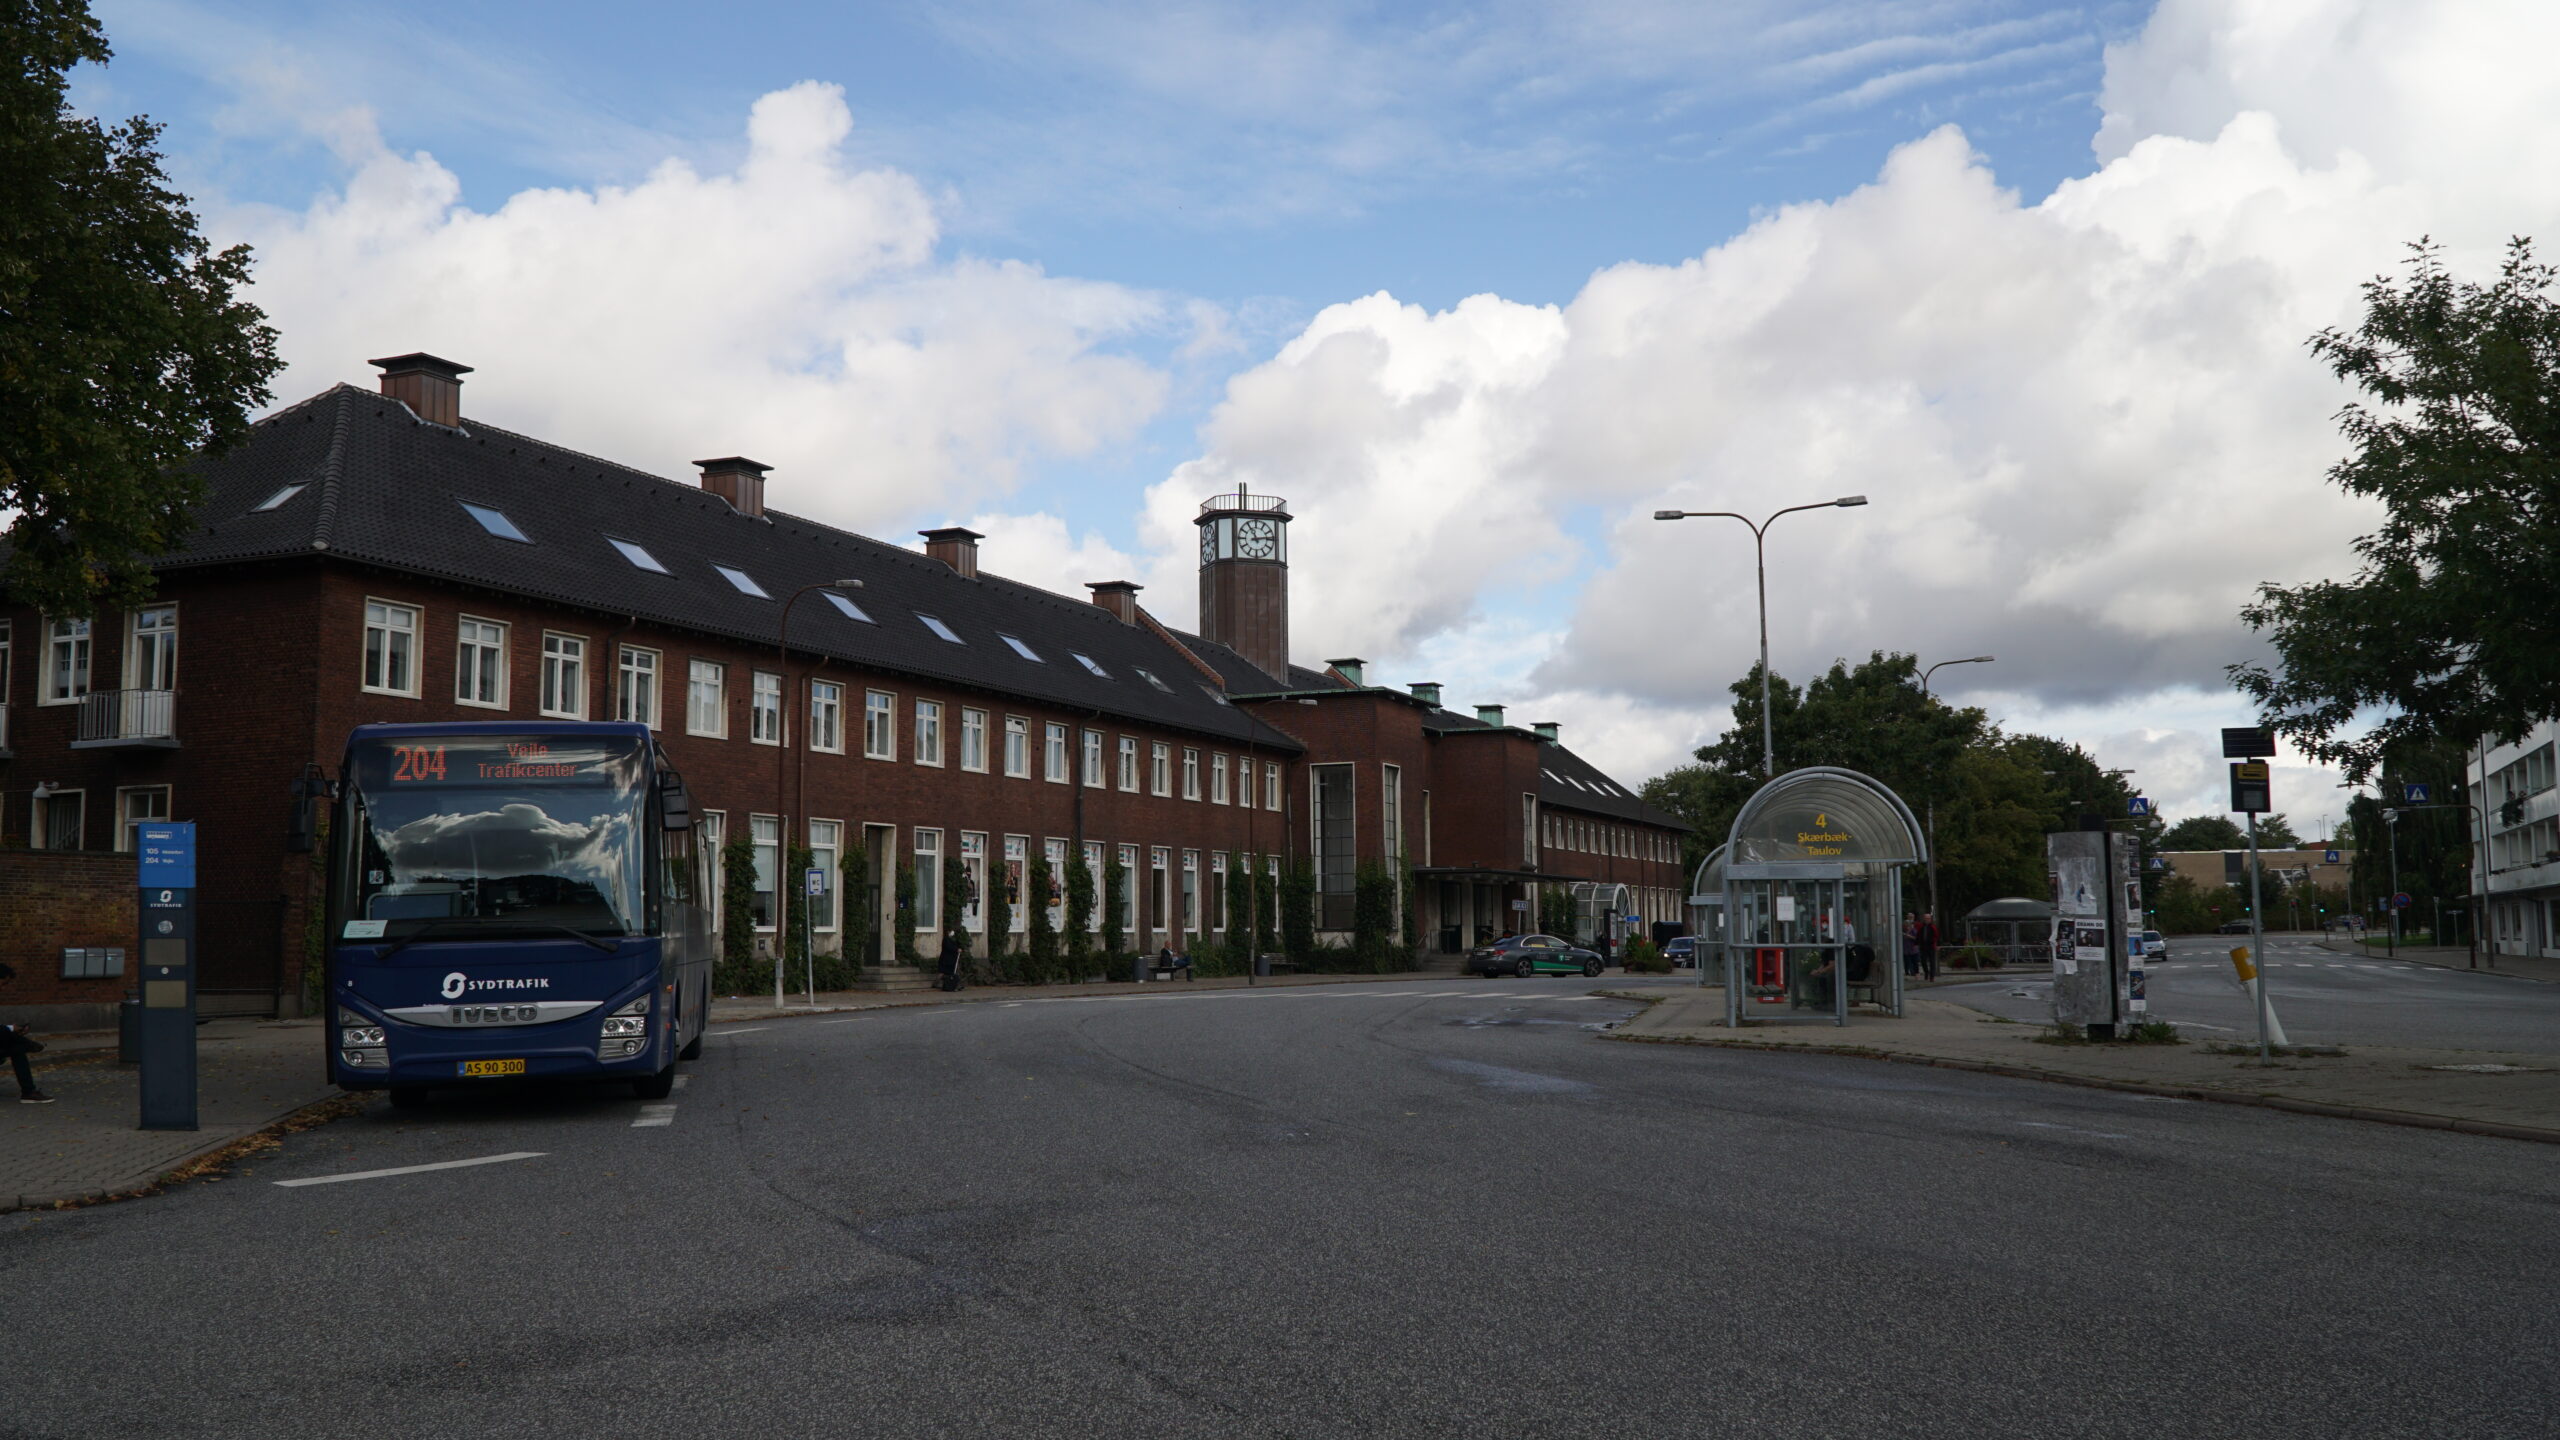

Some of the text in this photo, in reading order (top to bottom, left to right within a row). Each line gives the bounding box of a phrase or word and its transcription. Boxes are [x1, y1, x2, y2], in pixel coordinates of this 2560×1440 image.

[505, 743, 549, 760] Vejle
[393, 745, 447, 782] 204
[477, 762, 578, 778] Trafikcenter
[1815, 813, 1826, 829] 4
[1797, 832, 1853, 842] Skærbæk-
[1807, 845, 1842, 856] Taulov
[468, 978, 549, 990] SYDTRAFIK
[452, 1004, 538, 1024] IVECO
[466, 1060, 523, 1074] AS 90 300
